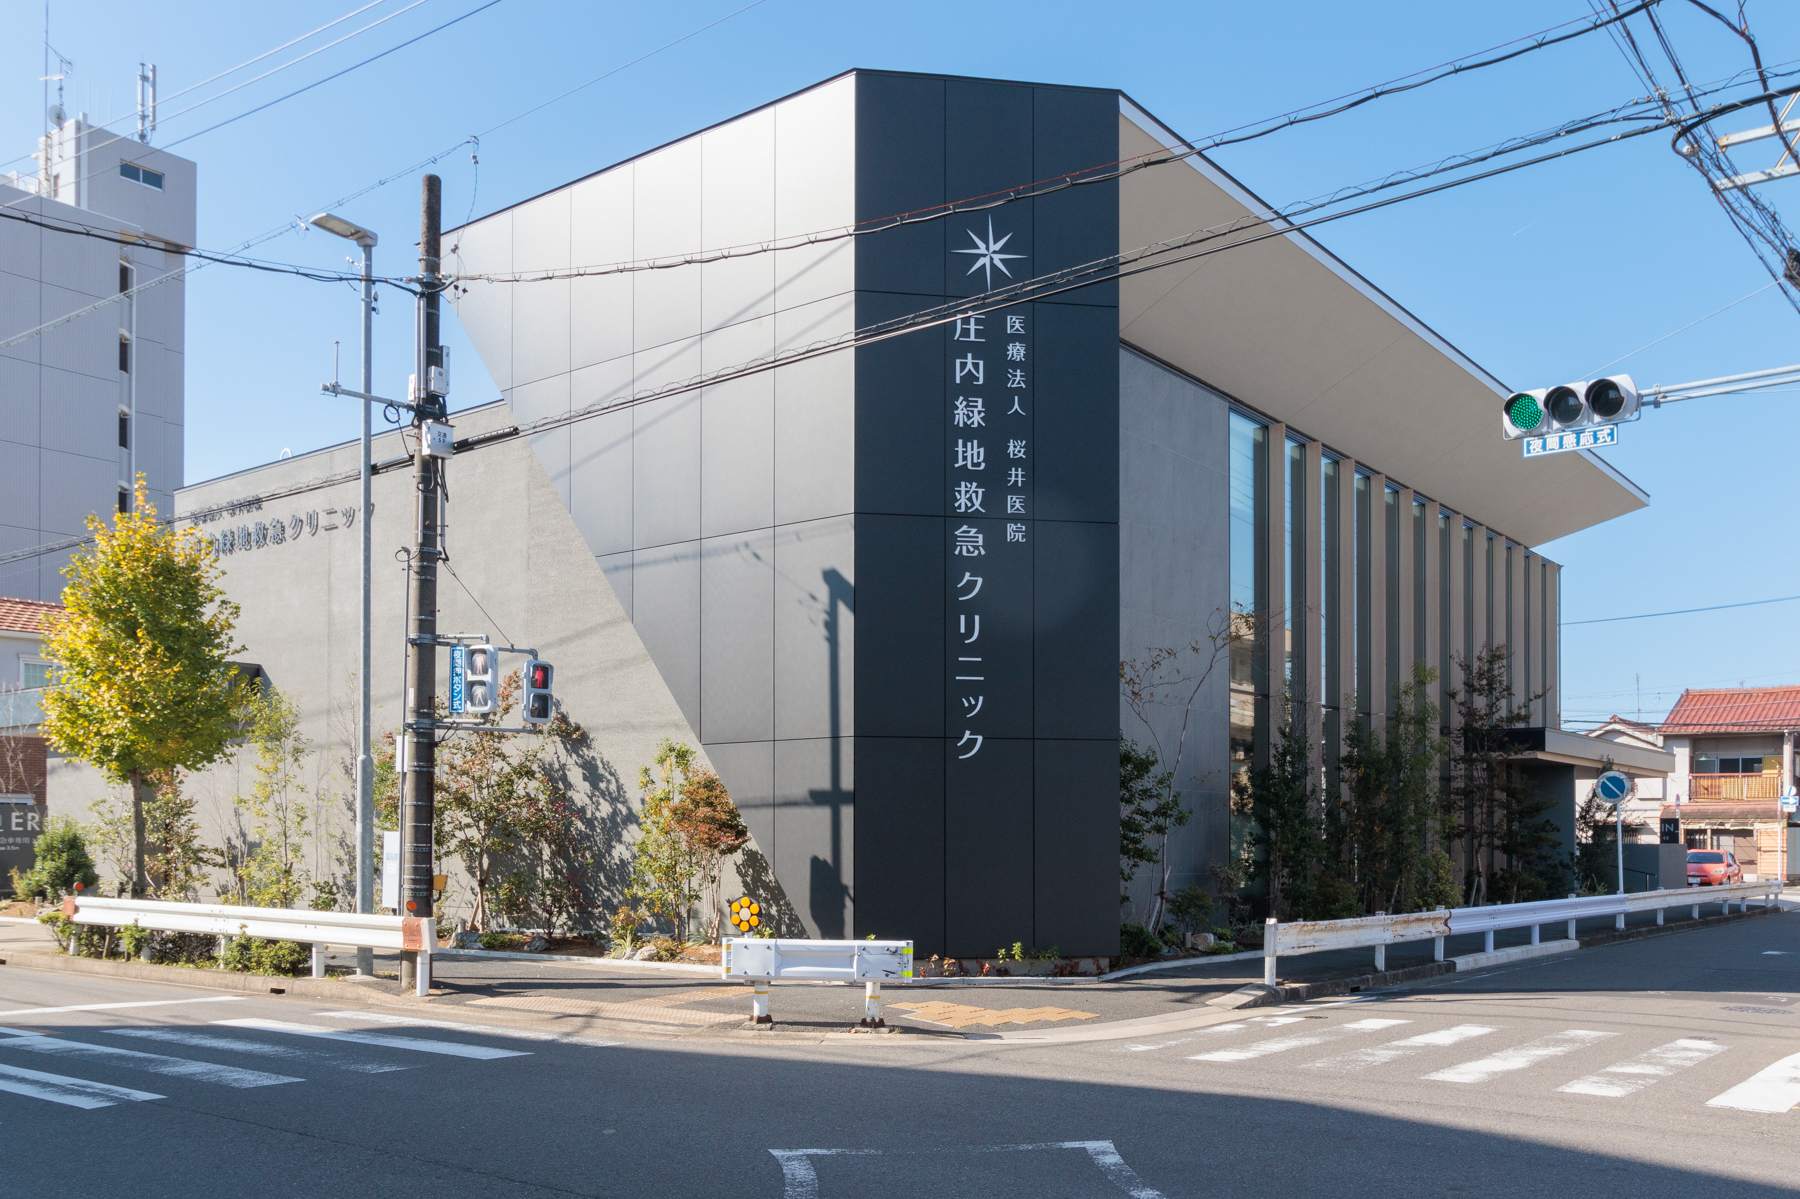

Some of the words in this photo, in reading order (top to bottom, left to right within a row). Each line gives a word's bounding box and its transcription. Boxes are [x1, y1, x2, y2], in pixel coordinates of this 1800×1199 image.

[1006, 314, 1026, 416] 医療法人
[1006, 438, 1026, 543] 桜井医院
[1529, 428, 1612, 454] 夜間感応式
[953, 310, 986, 759] 庄内緑地救急クリニック
[11, 812, 41, 831] ER
